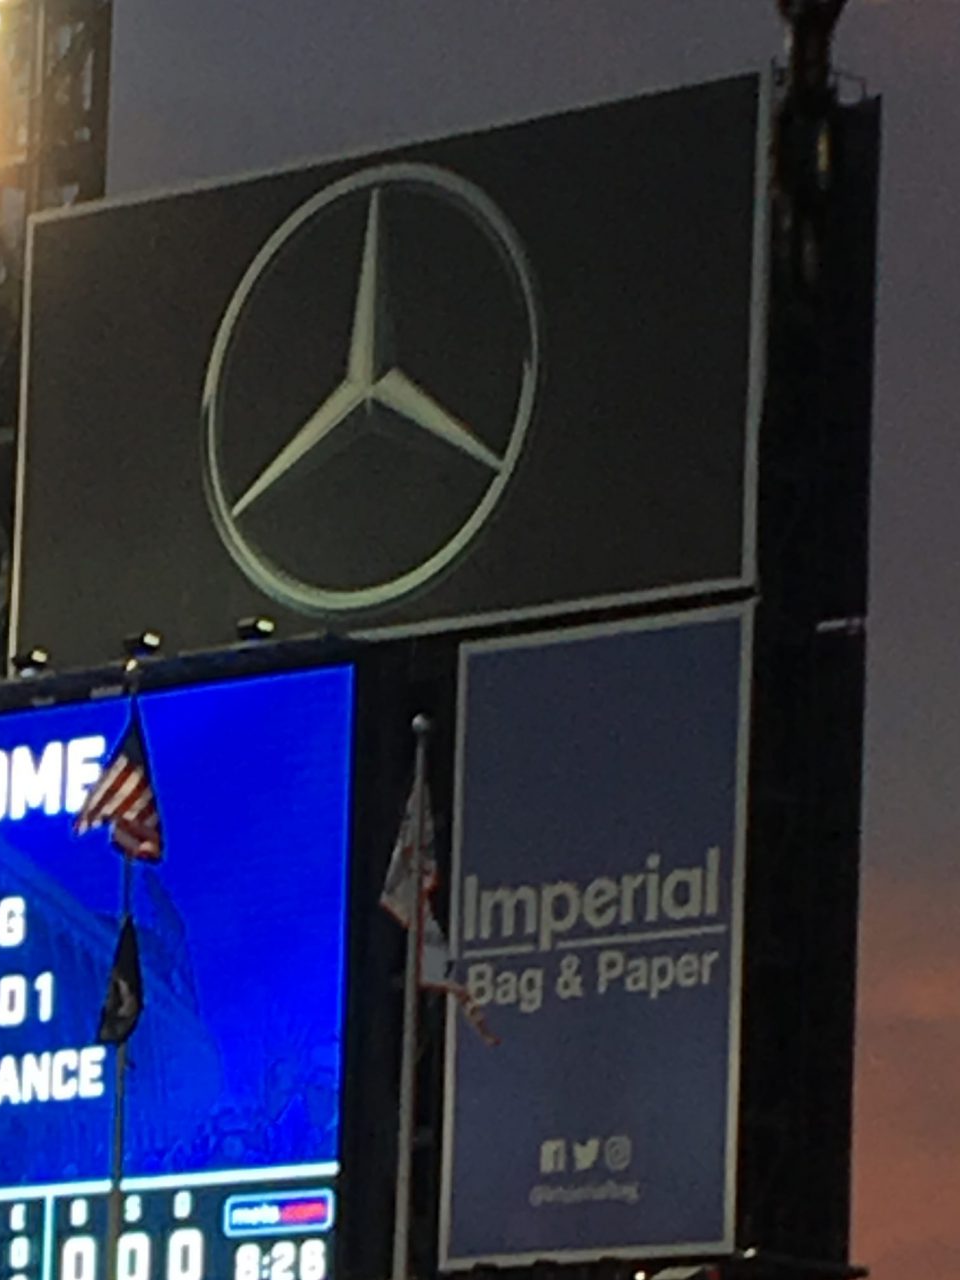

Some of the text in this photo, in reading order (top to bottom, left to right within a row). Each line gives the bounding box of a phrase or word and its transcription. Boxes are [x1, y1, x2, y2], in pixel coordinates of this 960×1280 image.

[463, 845, 721, 952] Imperial
[33, 971, 54, 1023] 1
[465, 950, 720, 1014] Bag & Paper
